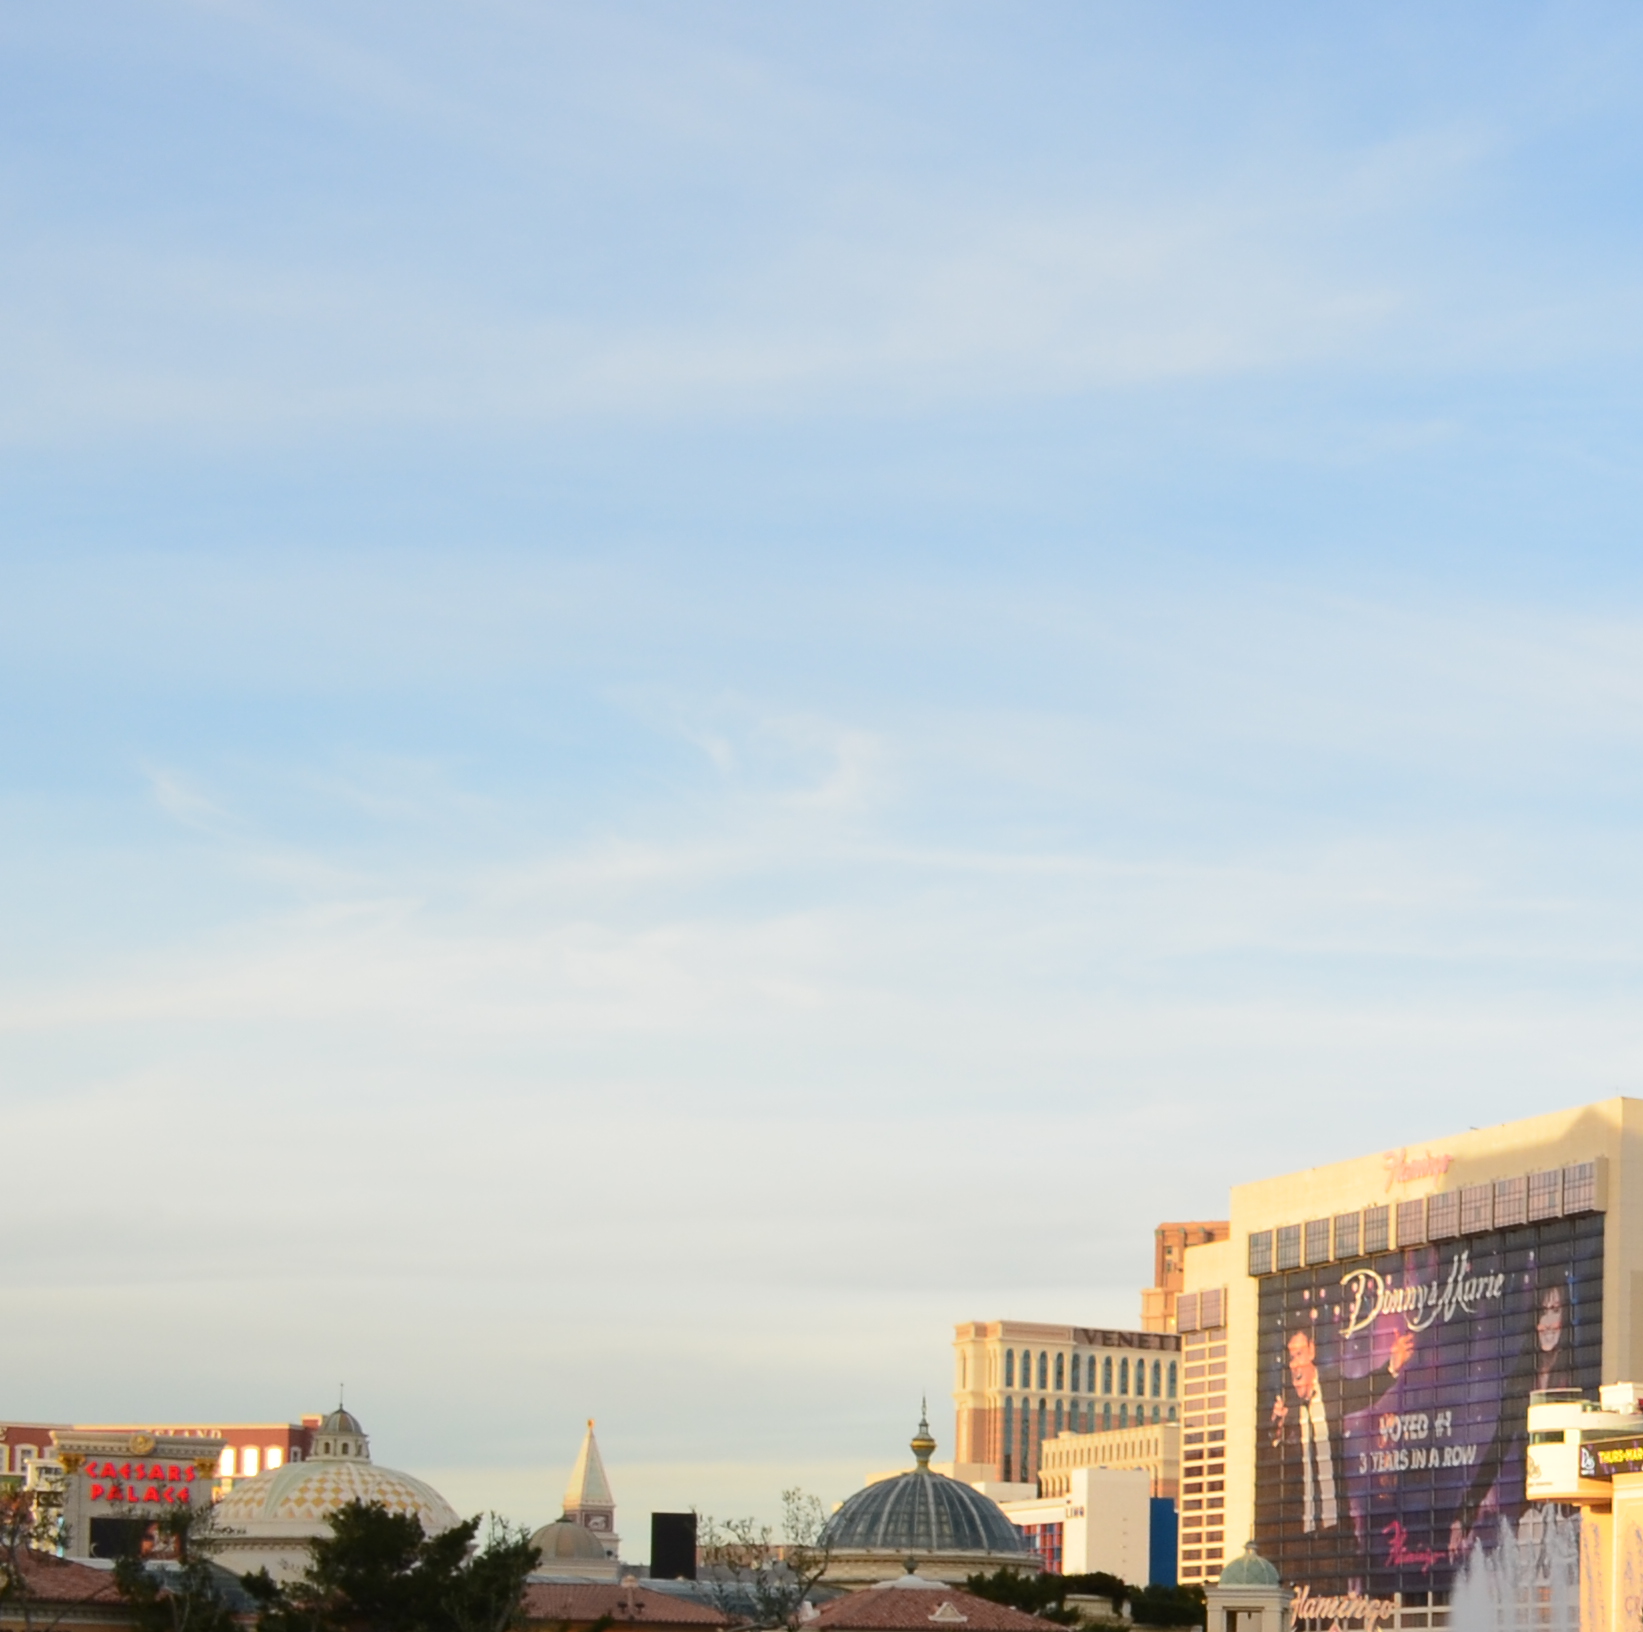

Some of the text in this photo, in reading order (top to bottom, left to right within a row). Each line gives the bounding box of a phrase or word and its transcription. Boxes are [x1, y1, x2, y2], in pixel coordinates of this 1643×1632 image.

[1339, 1268, 1429, 1339] Donny
[1407, 1250, 1505, 1331] Marie
[1379, 1411, 1453, 1442] VOTED #1
[84, 1461, 196, 1483] CAESARS
[1359, 1445, 1477, 1474] 3 YEARS IN A ROW
[91, 1484, 190, 1504] PALACE
[1382, 1520, 1447, 1574] Flamingo
[1290, 1584, 1401, 1632] Flamingo
